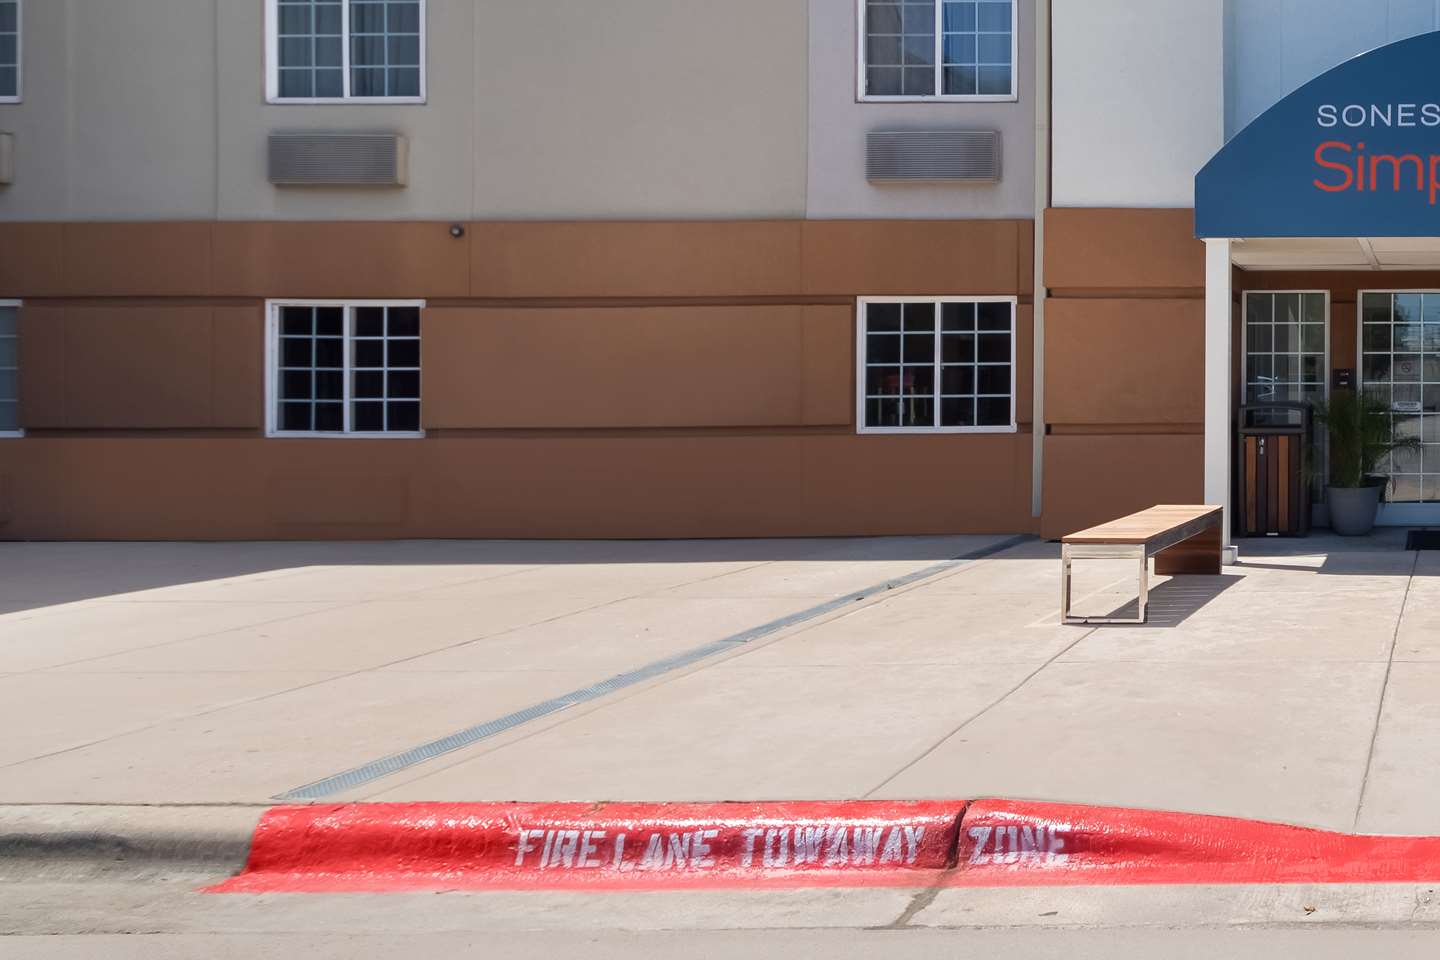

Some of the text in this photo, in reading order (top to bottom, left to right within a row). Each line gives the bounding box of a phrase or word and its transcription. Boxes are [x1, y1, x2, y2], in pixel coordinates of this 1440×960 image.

[513, 825, 1071, 872] FIRE LANE TOWAWAY ZONE
